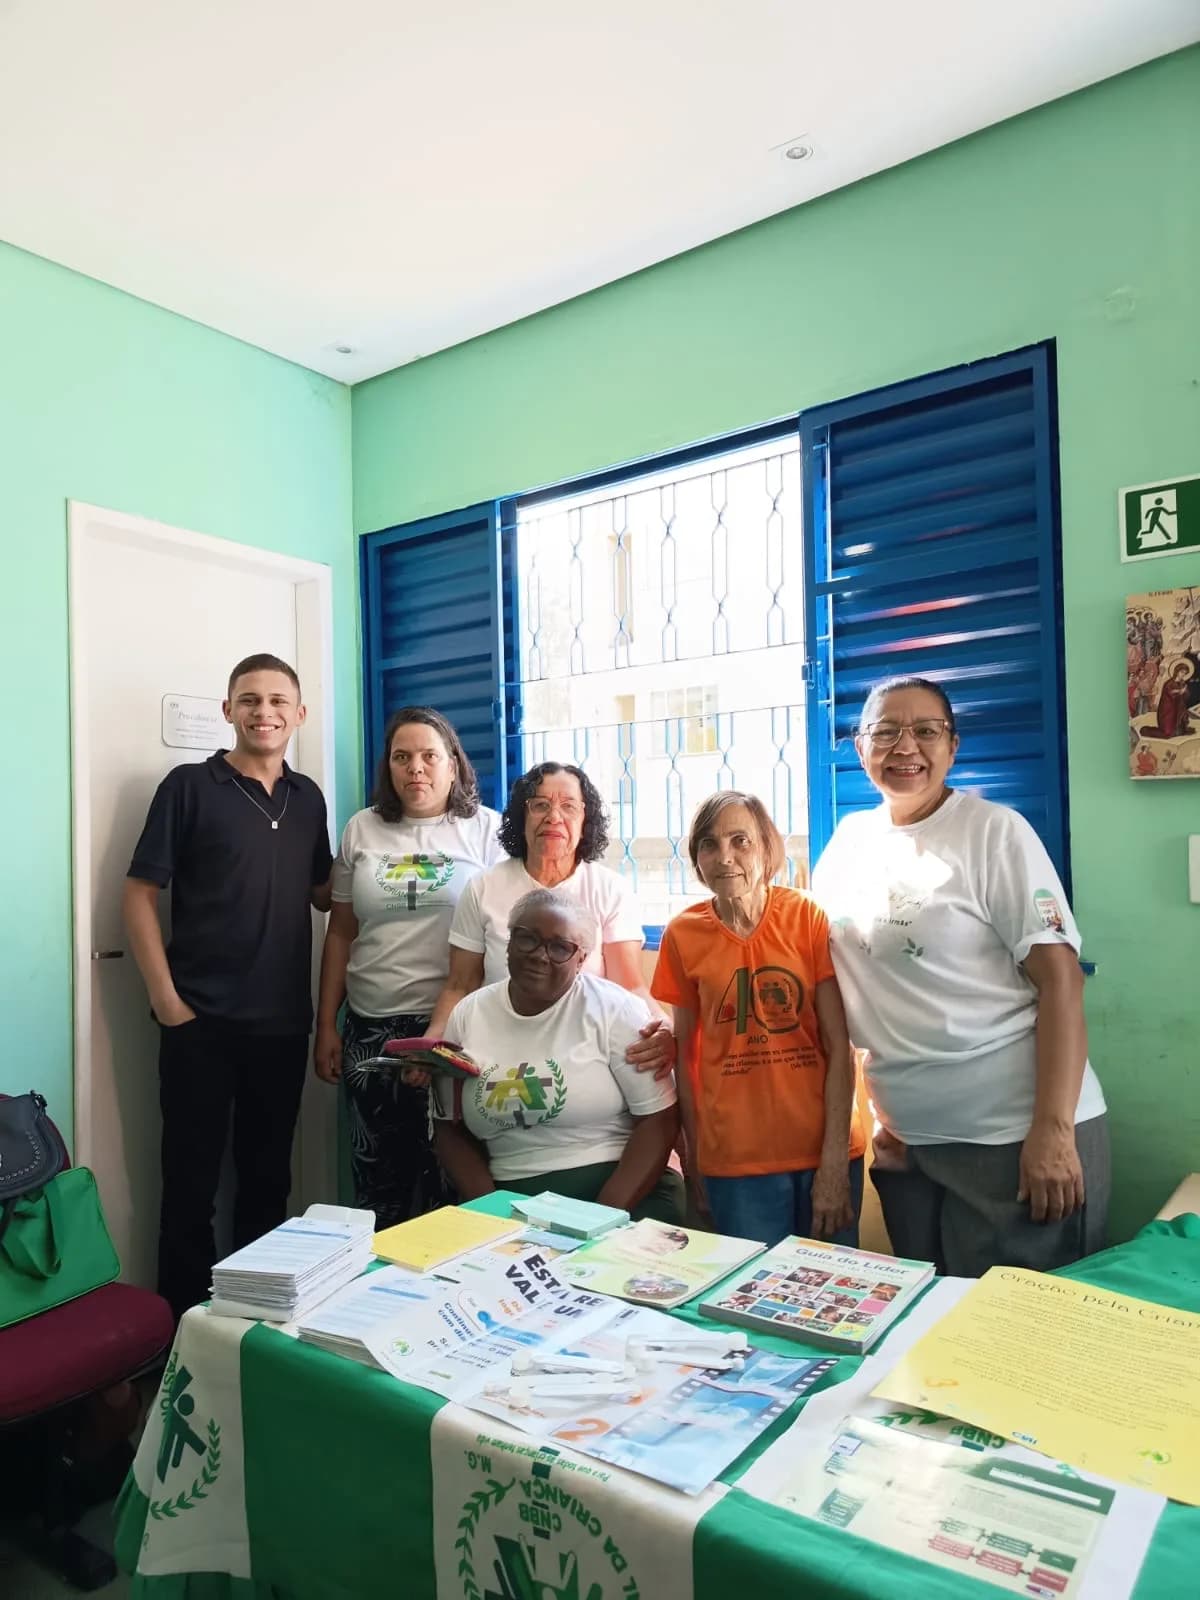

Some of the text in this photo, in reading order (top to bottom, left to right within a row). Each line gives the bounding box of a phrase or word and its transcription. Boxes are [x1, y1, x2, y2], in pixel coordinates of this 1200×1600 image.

[796, 1248, 832, 1260] Guia
[837, 1257, 858, 1265] do
[517, 1502, 562, 1533] CNBB
[519, 1479, 602, 1537] CRIANÇA
[603, 1535, 628, 1574] DA
